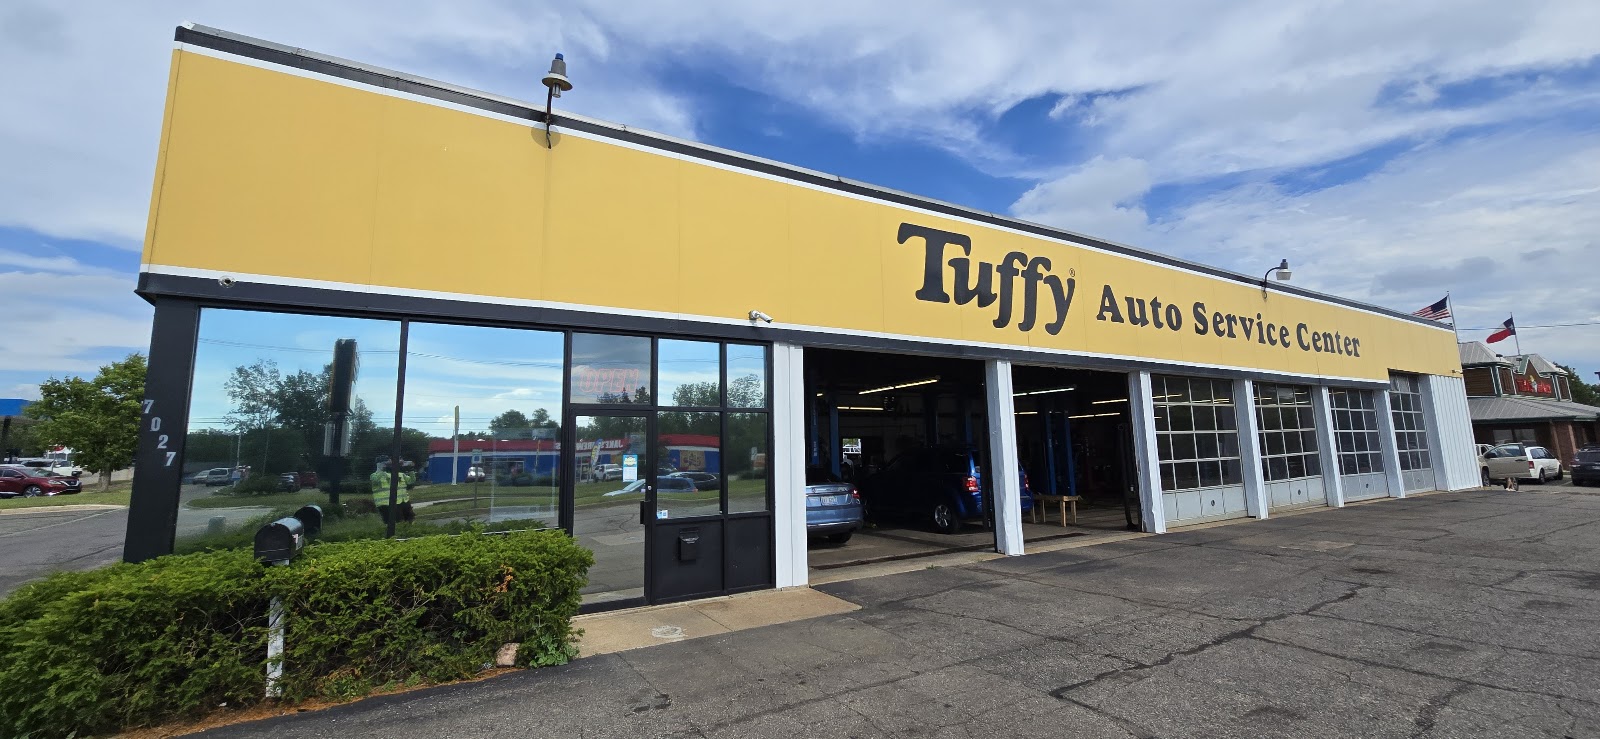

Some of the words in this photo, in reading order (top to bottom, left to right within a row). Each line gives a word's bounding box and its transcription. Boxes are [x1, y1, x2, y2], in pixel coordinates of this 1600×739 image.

[897, 222, 1076, 336] Tuffy
[1096, 284, 1183, 331] Auto
[1192, 301, 1292, 349] Service
[1296, 322, 1361, 358] Center
[579, 368, 640, 393] OPEN
[142, 399, 177, 467] 7027
